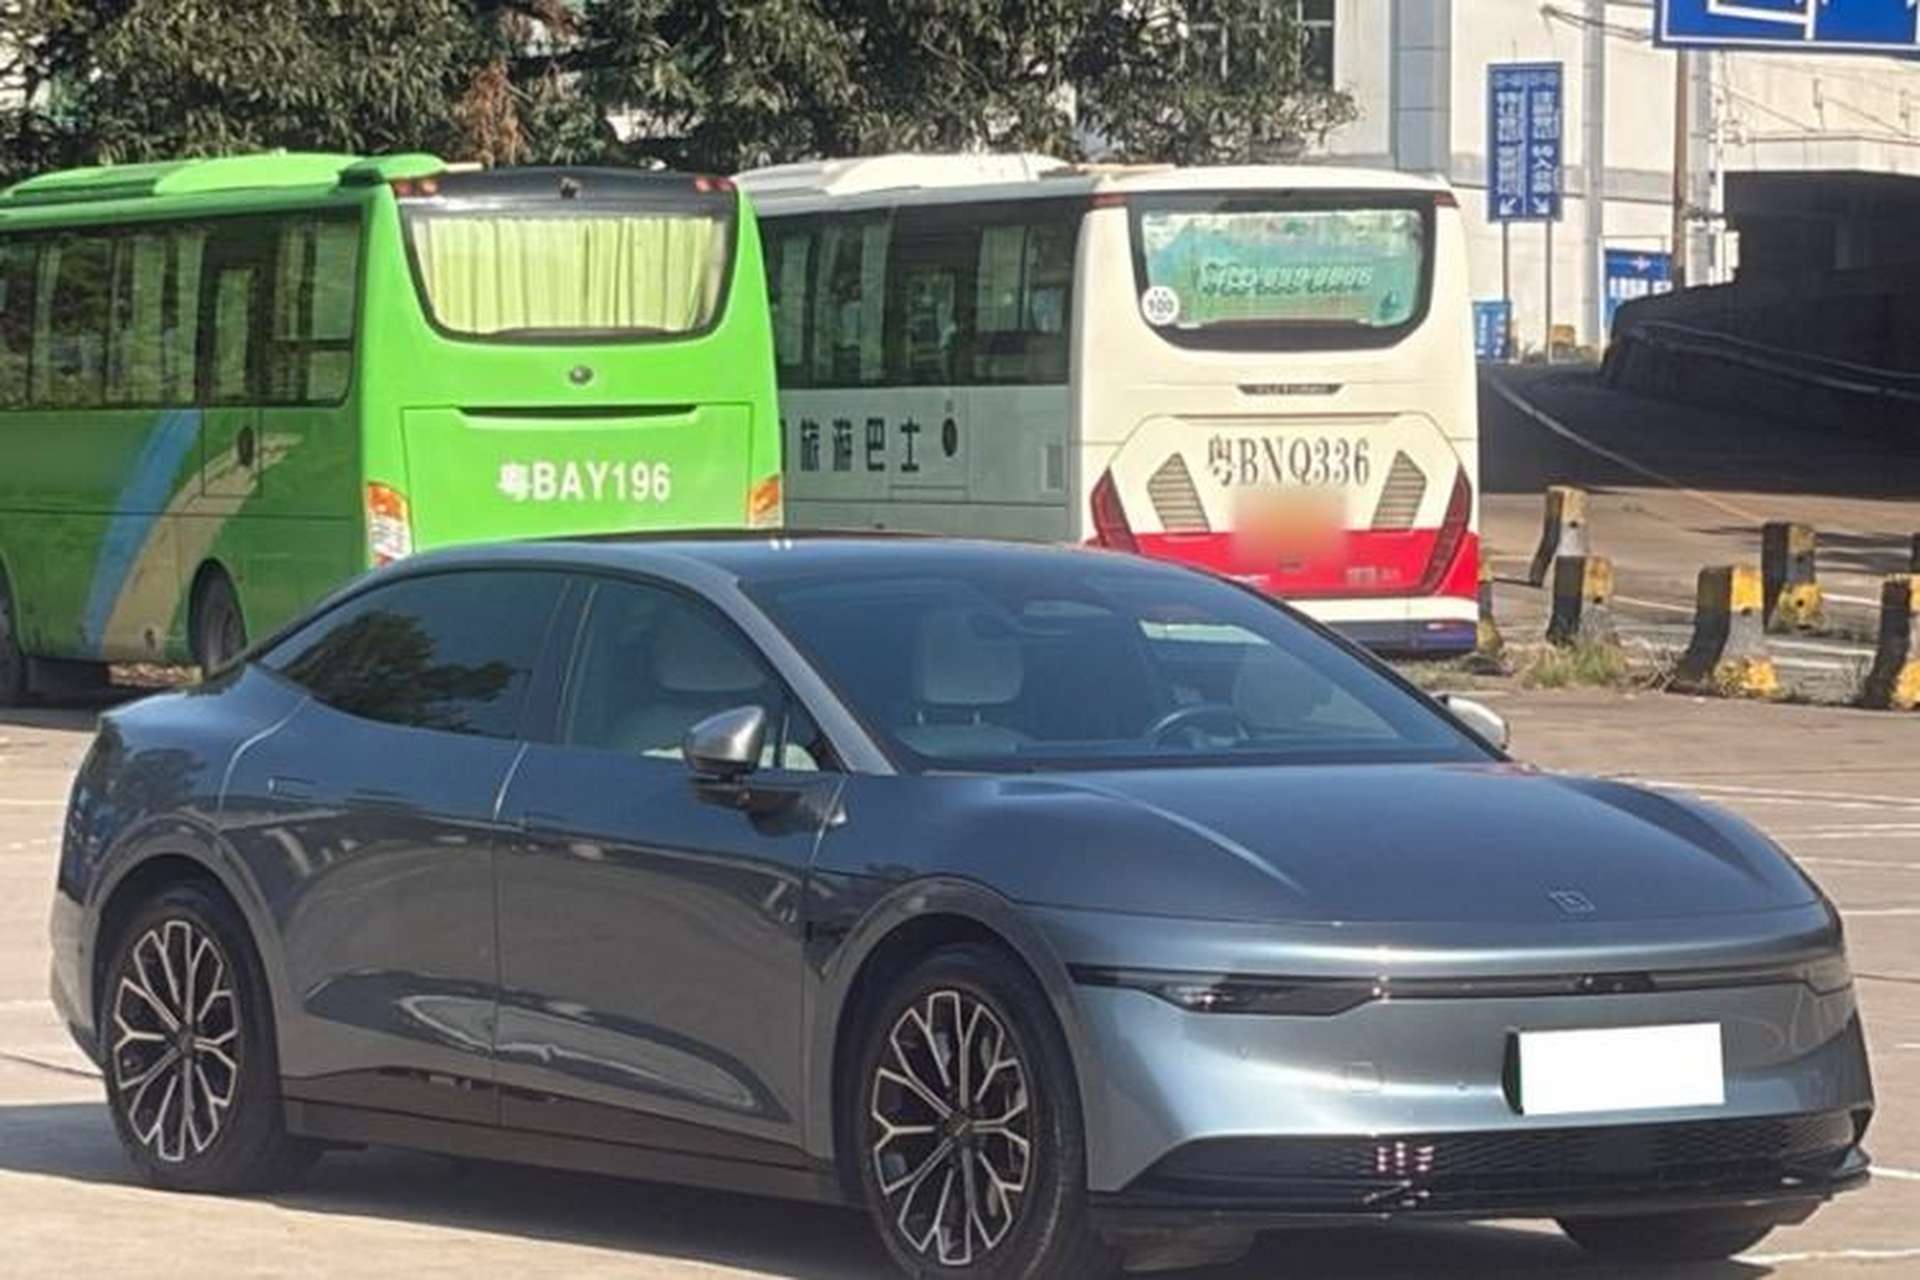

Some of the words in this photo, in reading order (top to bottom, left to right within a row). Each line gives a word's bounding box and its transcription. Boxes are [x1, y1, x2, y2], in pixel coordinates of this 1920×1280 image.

[780, 416, 920, 472] 旅游巴士
[1207, 435, 1369, 486] 粤BNQ336
[499, 462, 671, 502] 粤BAY196
